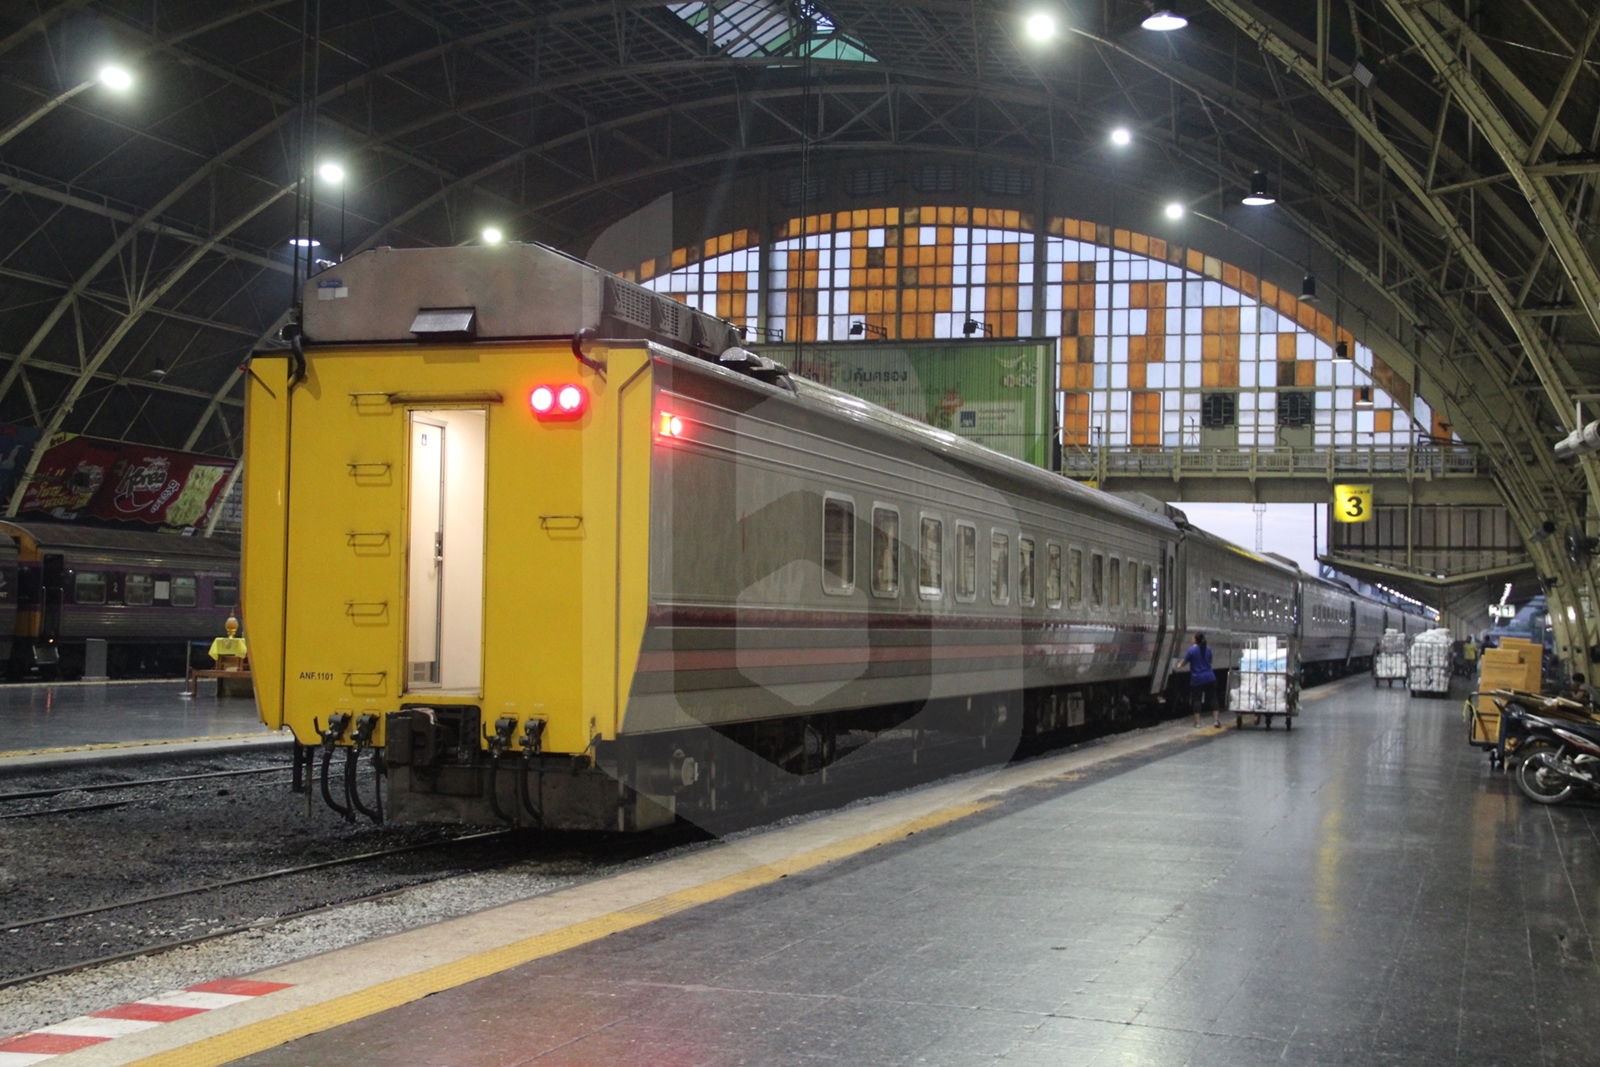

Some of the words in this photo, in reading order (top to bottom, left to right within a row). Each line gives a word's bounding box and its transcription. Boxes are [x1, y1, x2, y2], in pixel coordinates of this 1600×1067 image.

[115, 465, 167, 498] Korea
[1346, 496, 1363, 517] 3
[299, 672, 333, 680] ANF.1101
